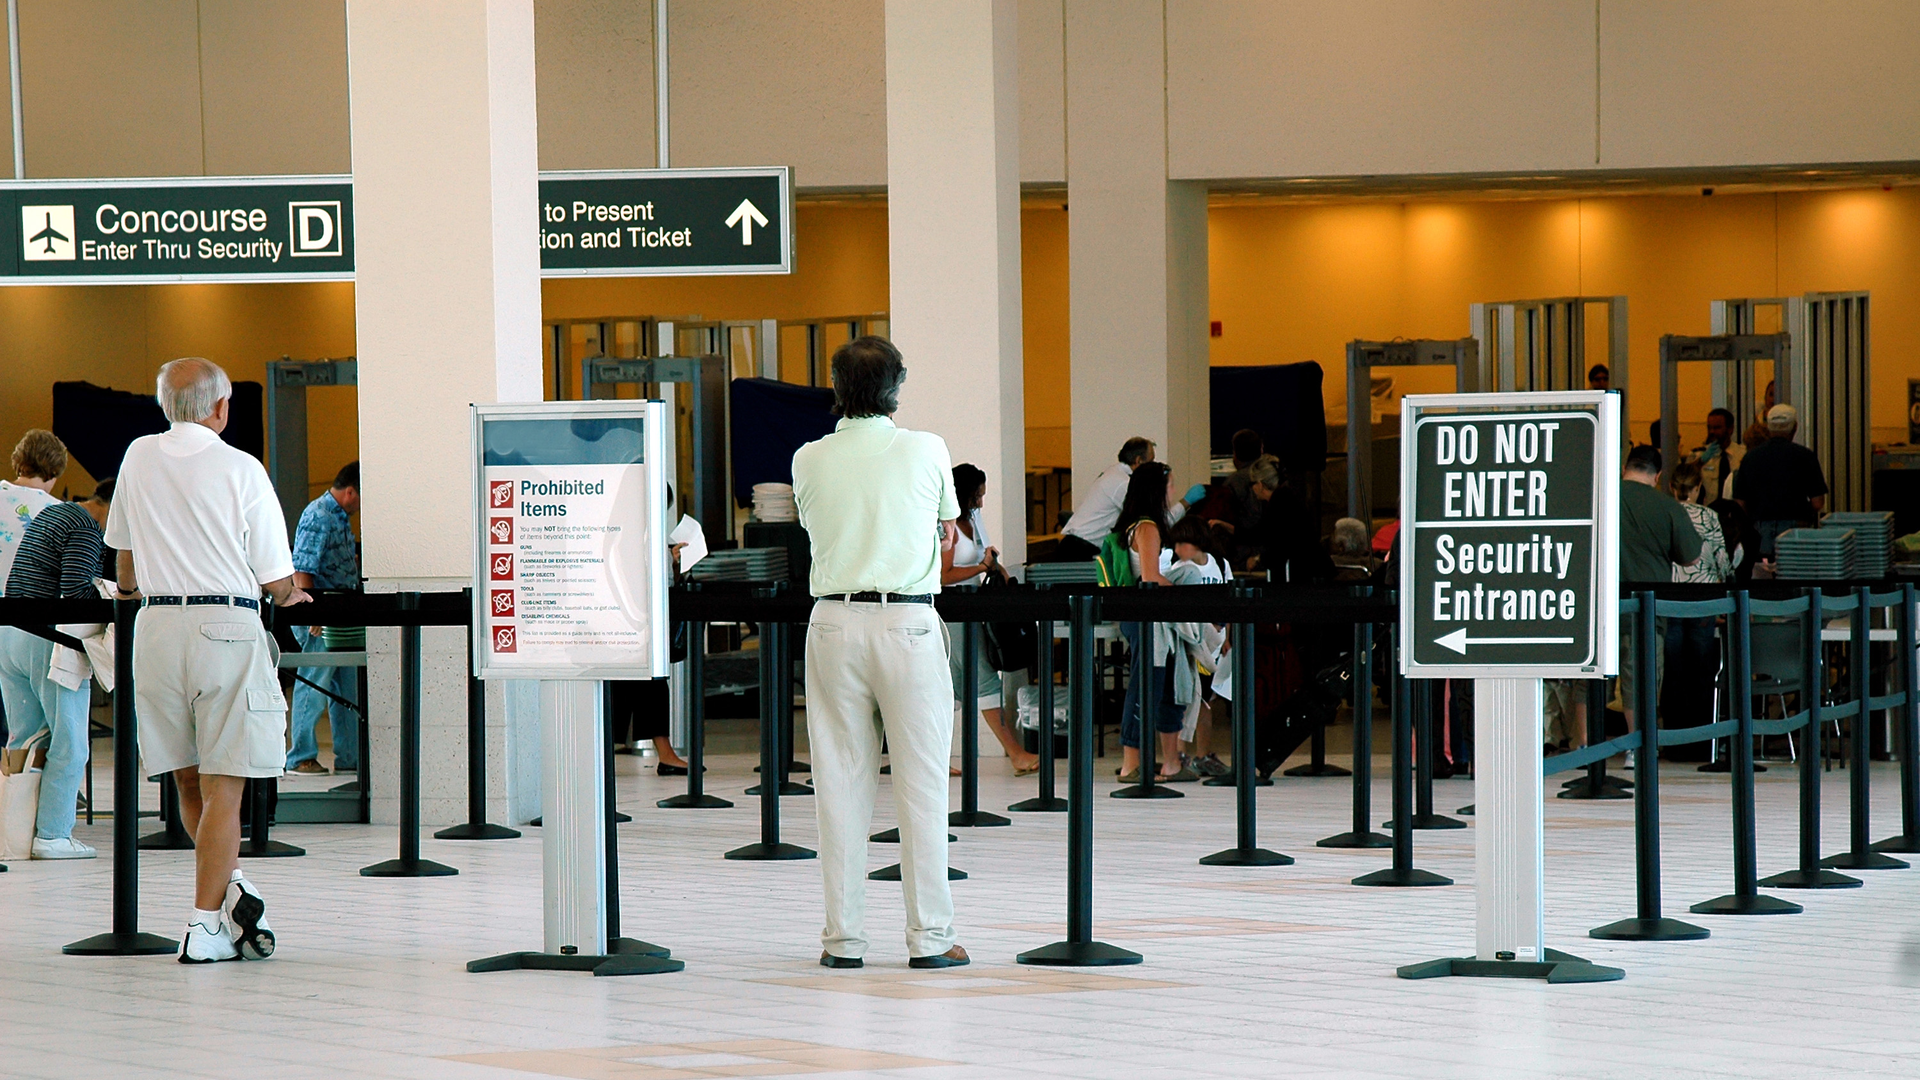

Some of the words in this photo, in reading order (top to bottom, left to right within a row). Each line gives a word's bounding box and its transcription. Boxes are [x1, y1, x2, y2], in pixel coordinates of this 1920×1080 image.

[95, 203, 267, 234] Concourse
[545, 203, 566, 222] to
[573, 201, 654, 222] Present
[299, 208, 333, 250] D
[580, 228, 621, 249] and
[627, 227, 692, 248] Ticket
[82, 240, 137, 261] Enter
[143, 239, 191, 260] Thru
[198, 238, 283, 263] Security
[1436, 425, 1478, 465] DO
[1495, 423, 1559, 463] NOT
[521, 480, 604, 496] Prohibited
[1444, 471, 1548, 518] ENTER
[521, 501, 567, 517] Items
[1436, 534, 1573, 579] Security
[1433, 581, 1576, 621] Entrance
